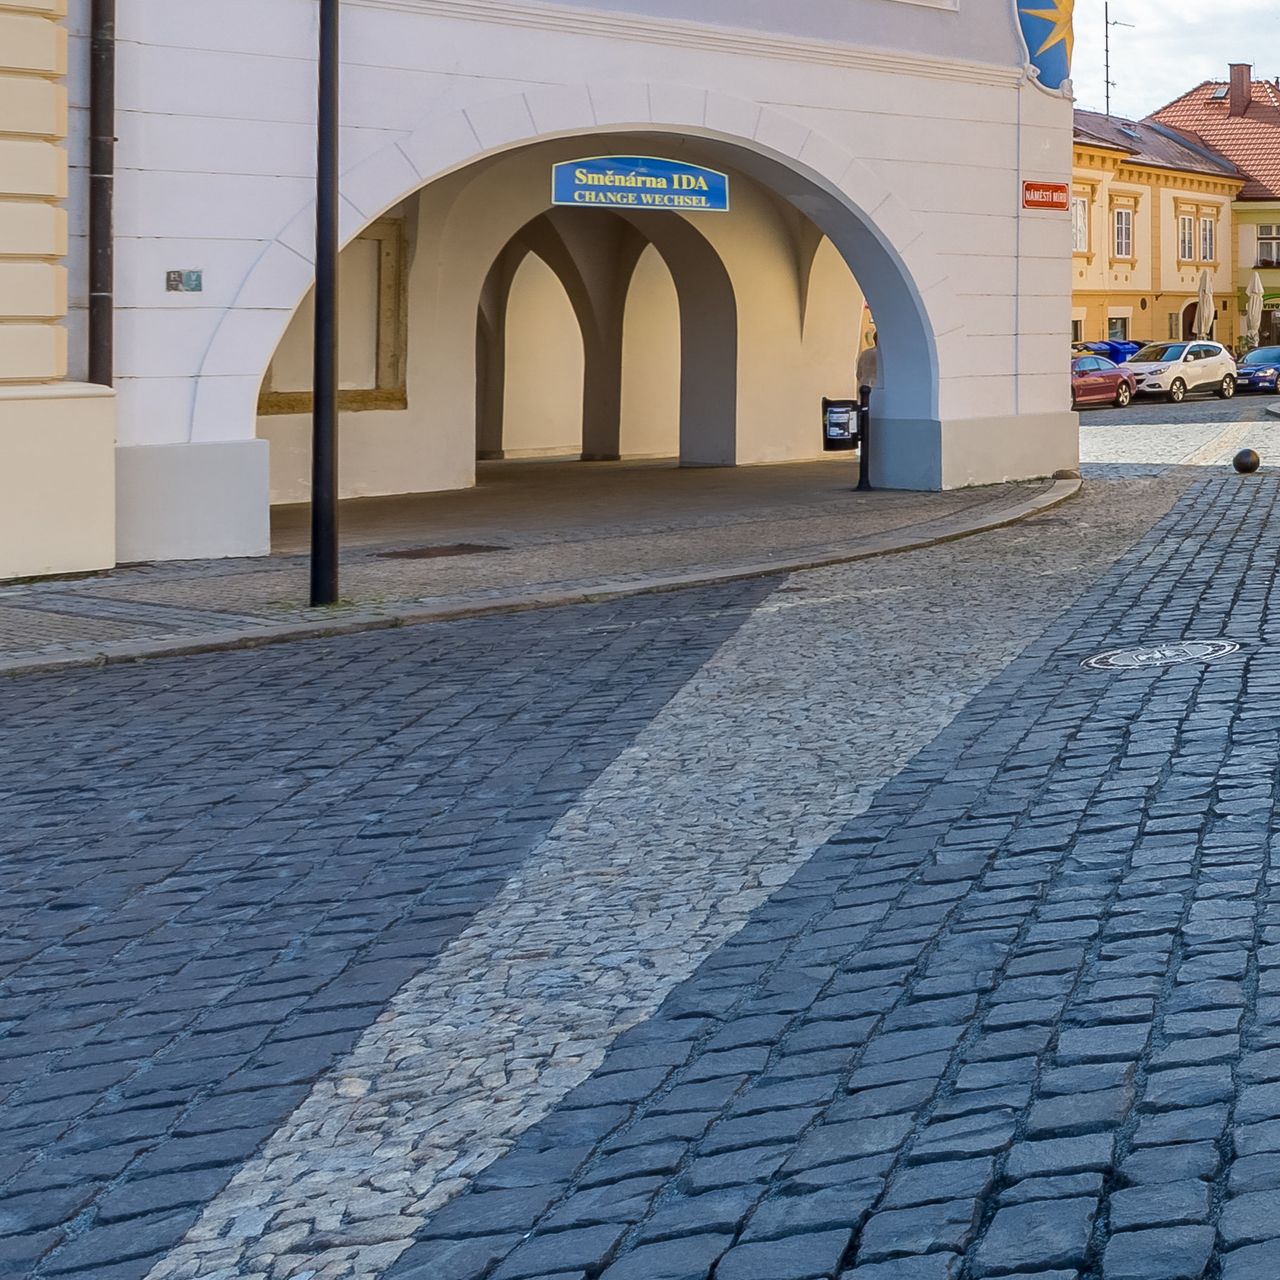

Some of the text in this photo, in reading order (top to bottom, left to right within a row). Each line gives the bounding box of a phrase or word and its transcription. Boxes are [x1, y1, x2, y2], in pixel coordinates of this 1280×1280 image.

[574, 168, 709, 191] Směnárna IDA
[574, 190, 710, 207] CHANGE WECHSEL
[1025, 188, 1052, 202] NÁMĚSTÍ
